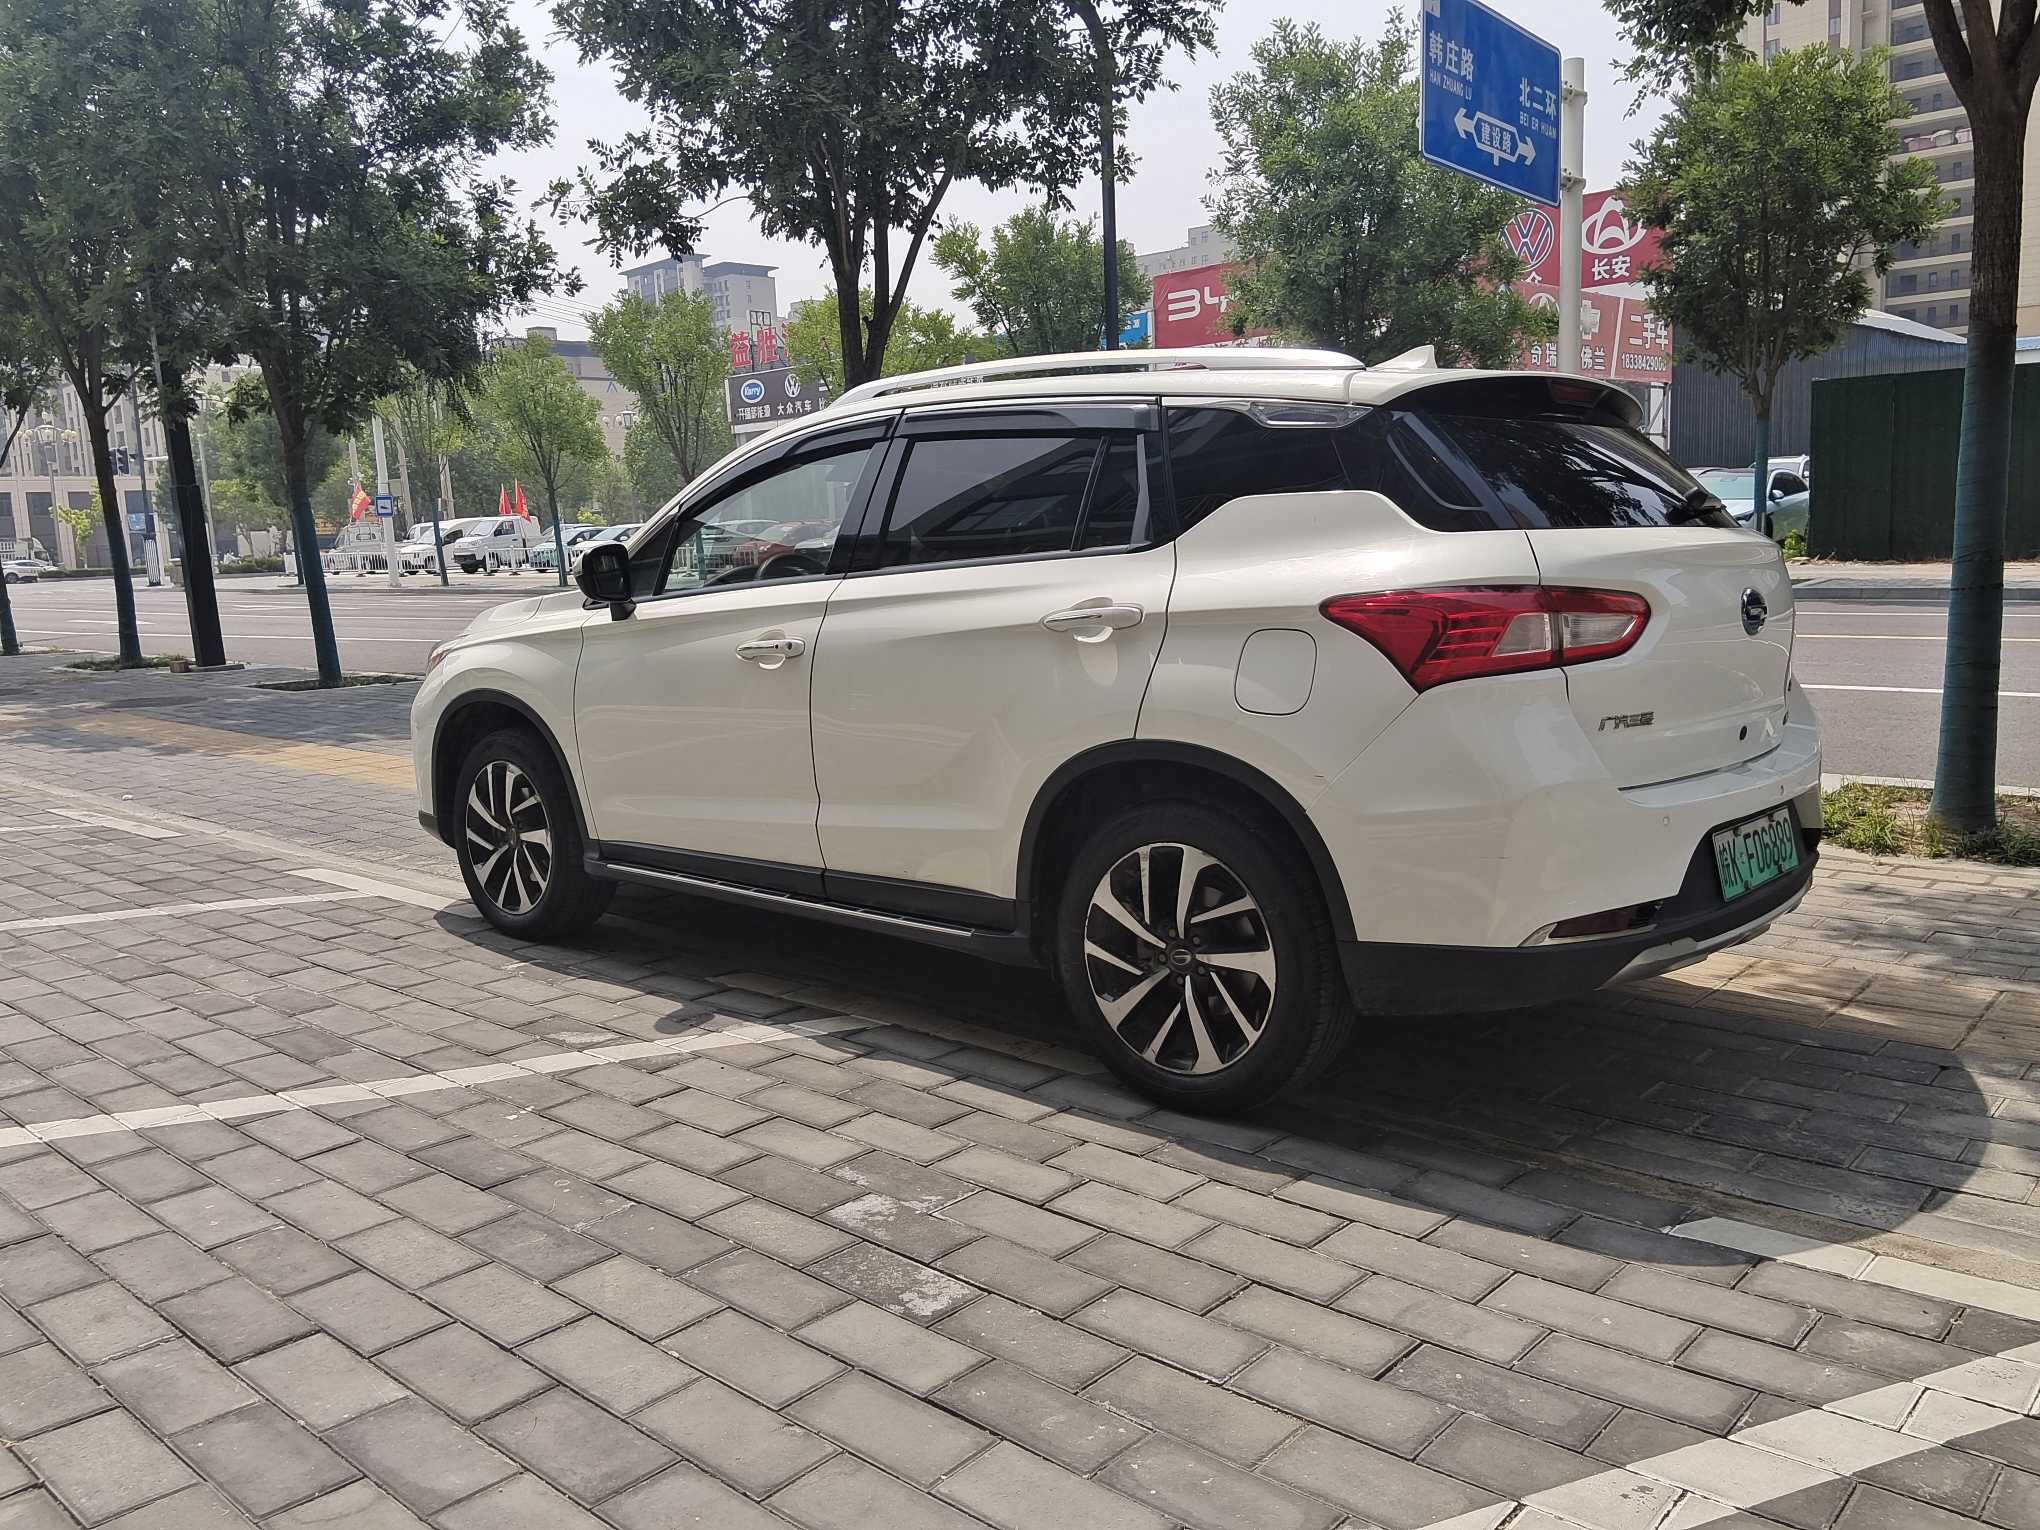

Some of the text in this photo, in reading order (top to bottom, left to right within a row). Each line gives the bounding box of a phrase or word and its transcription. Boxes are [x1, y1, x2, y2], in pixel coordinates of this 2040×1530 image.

[1429, 30, 1474, 82] 韩庄路
[1430, 69, 1472, 101] HAN ZHUANG LU
[1519, 77, 1557, 121] 北二环
[1481, 121, 1512, 154] 建设路
[1519, 111, 1557, 139] BEI ER HUAN
[1591, 255, 1631, 281] 长安
[1629, 313, 1668, 351] 二手车
[1531, 341, 1558, 368] 奇瑞
[777, 400, 812, 416] 大众汽车
